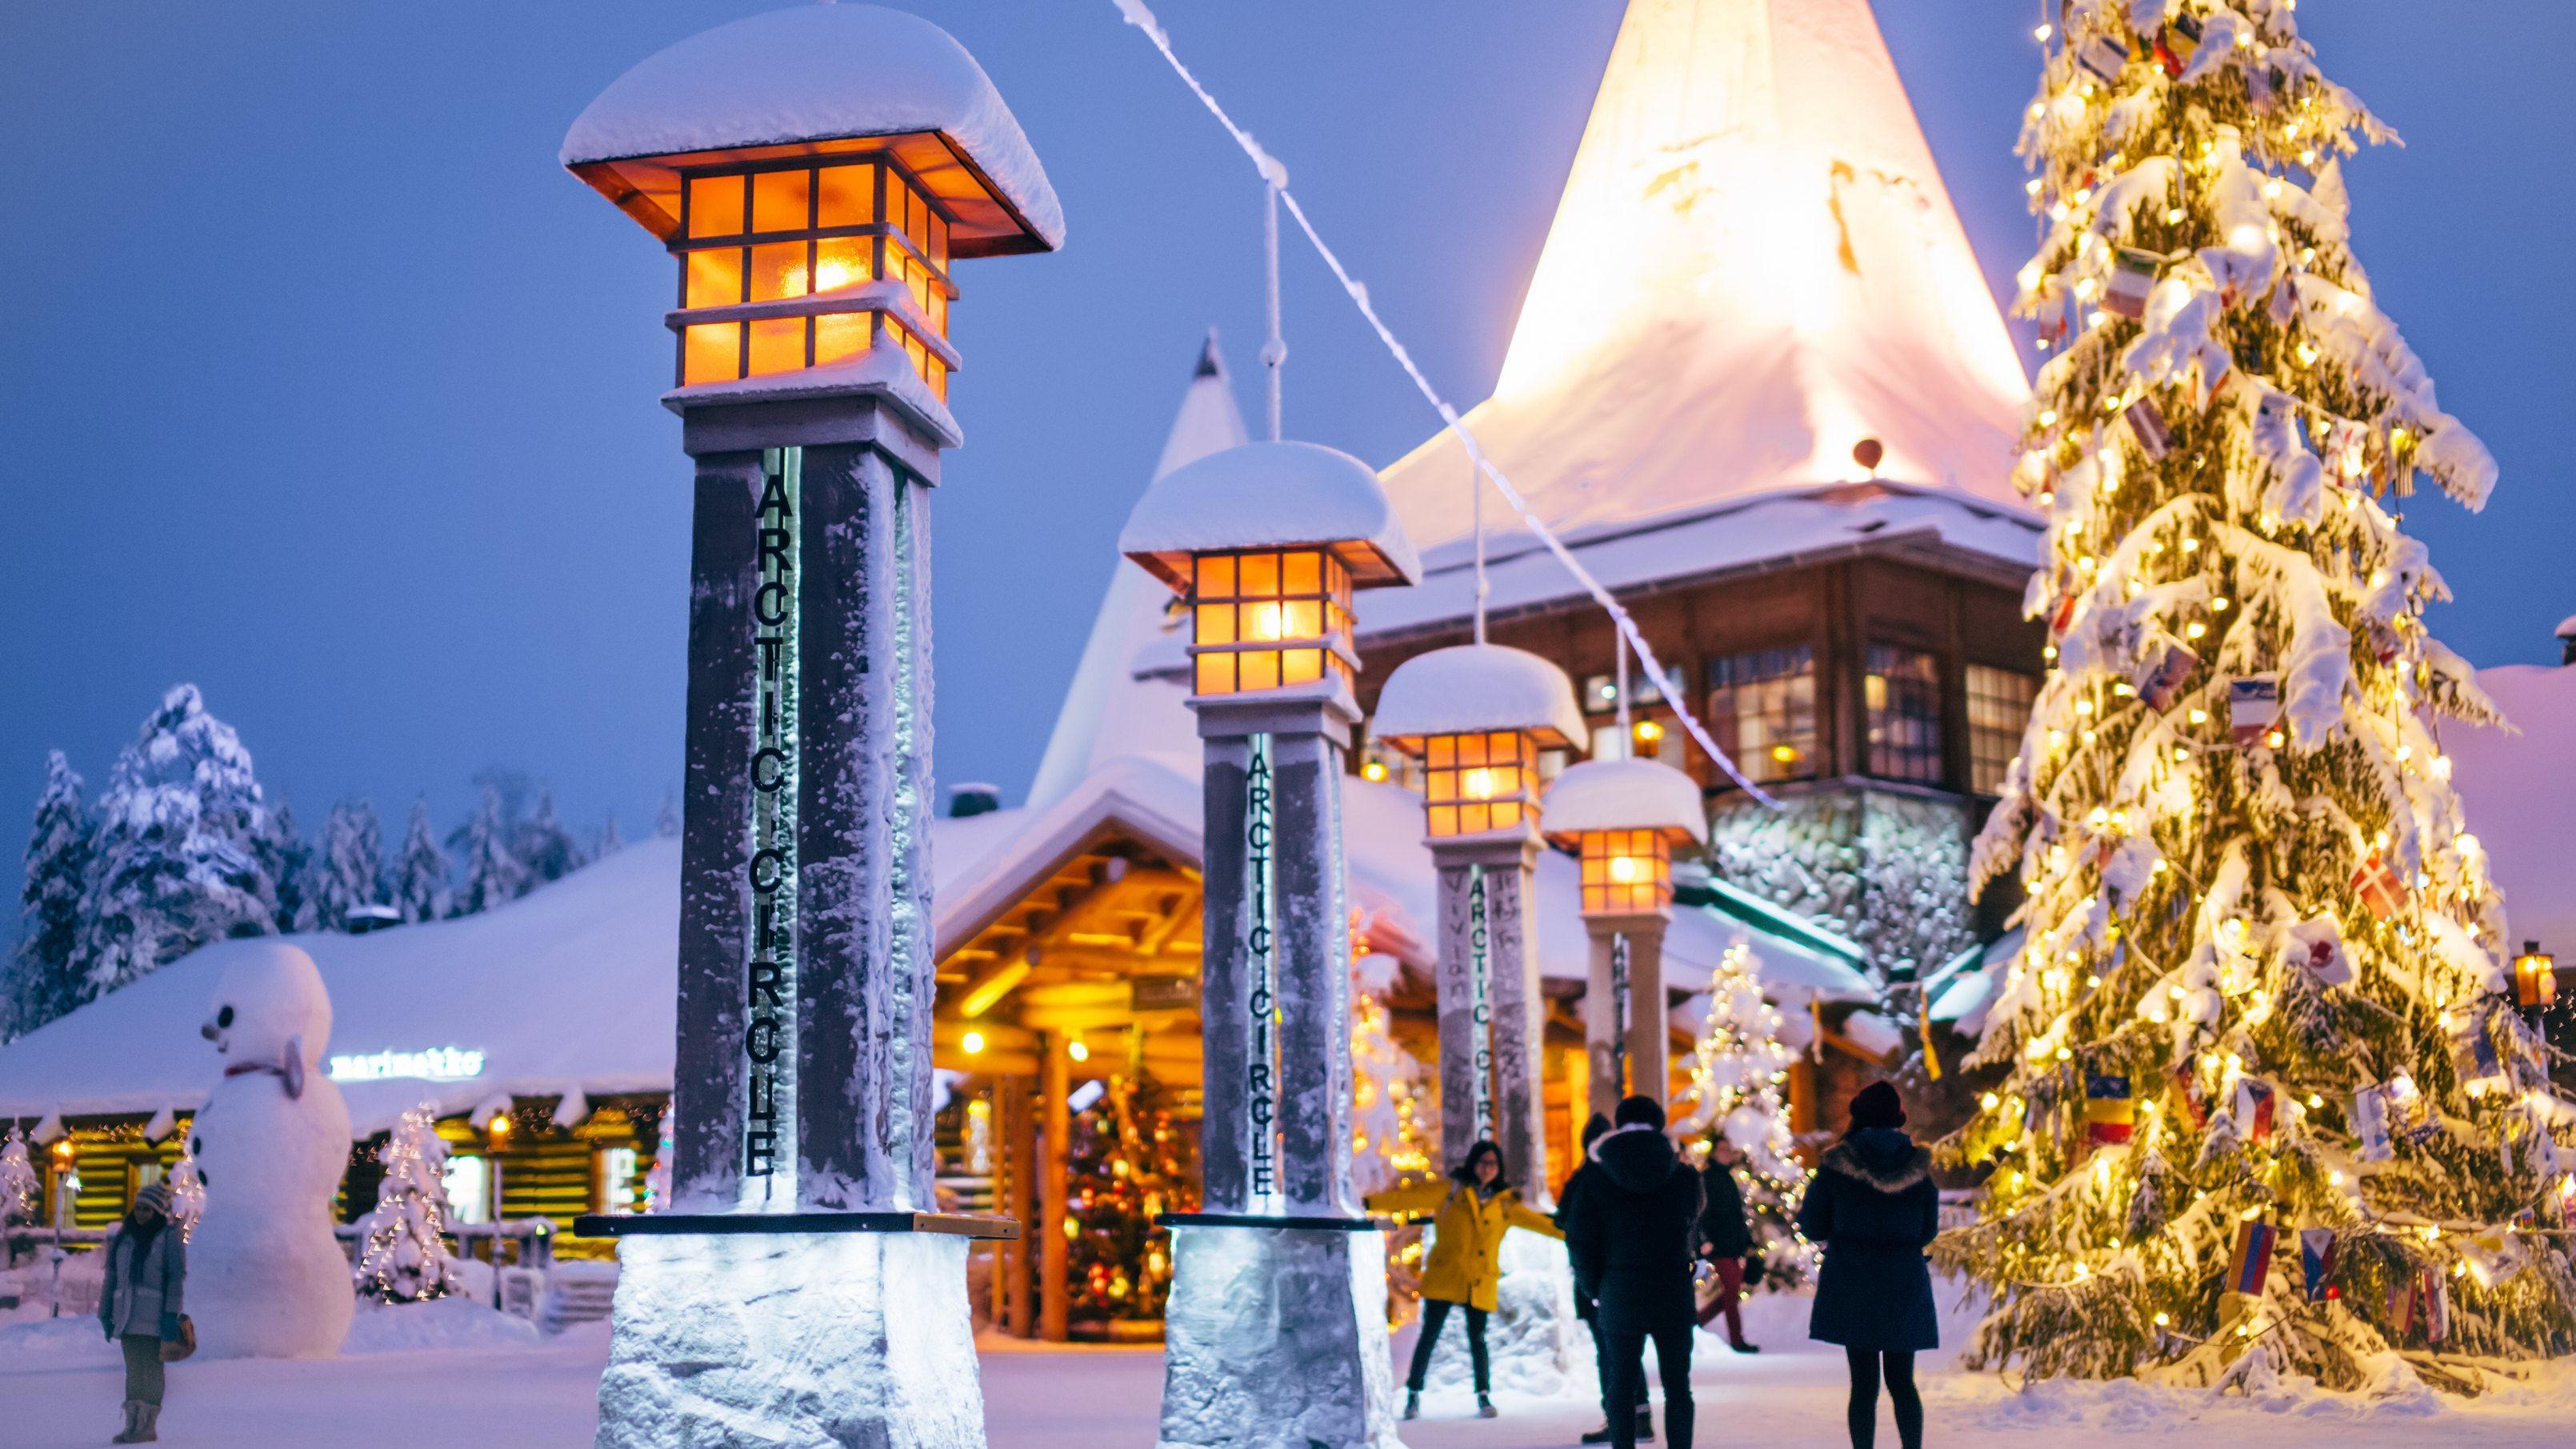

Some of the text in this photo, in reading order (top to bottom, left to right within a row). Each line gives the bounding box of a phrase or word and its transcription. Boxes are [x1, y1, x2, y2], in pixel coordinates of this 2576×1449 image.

[745, 474, 793, 1177] ARCTIC CIRCLE
[1246, 753, 1273, 1195] ARCTIC CIRCLE
[1470, 879, 1494, 1142] ARCTIC CIRC
